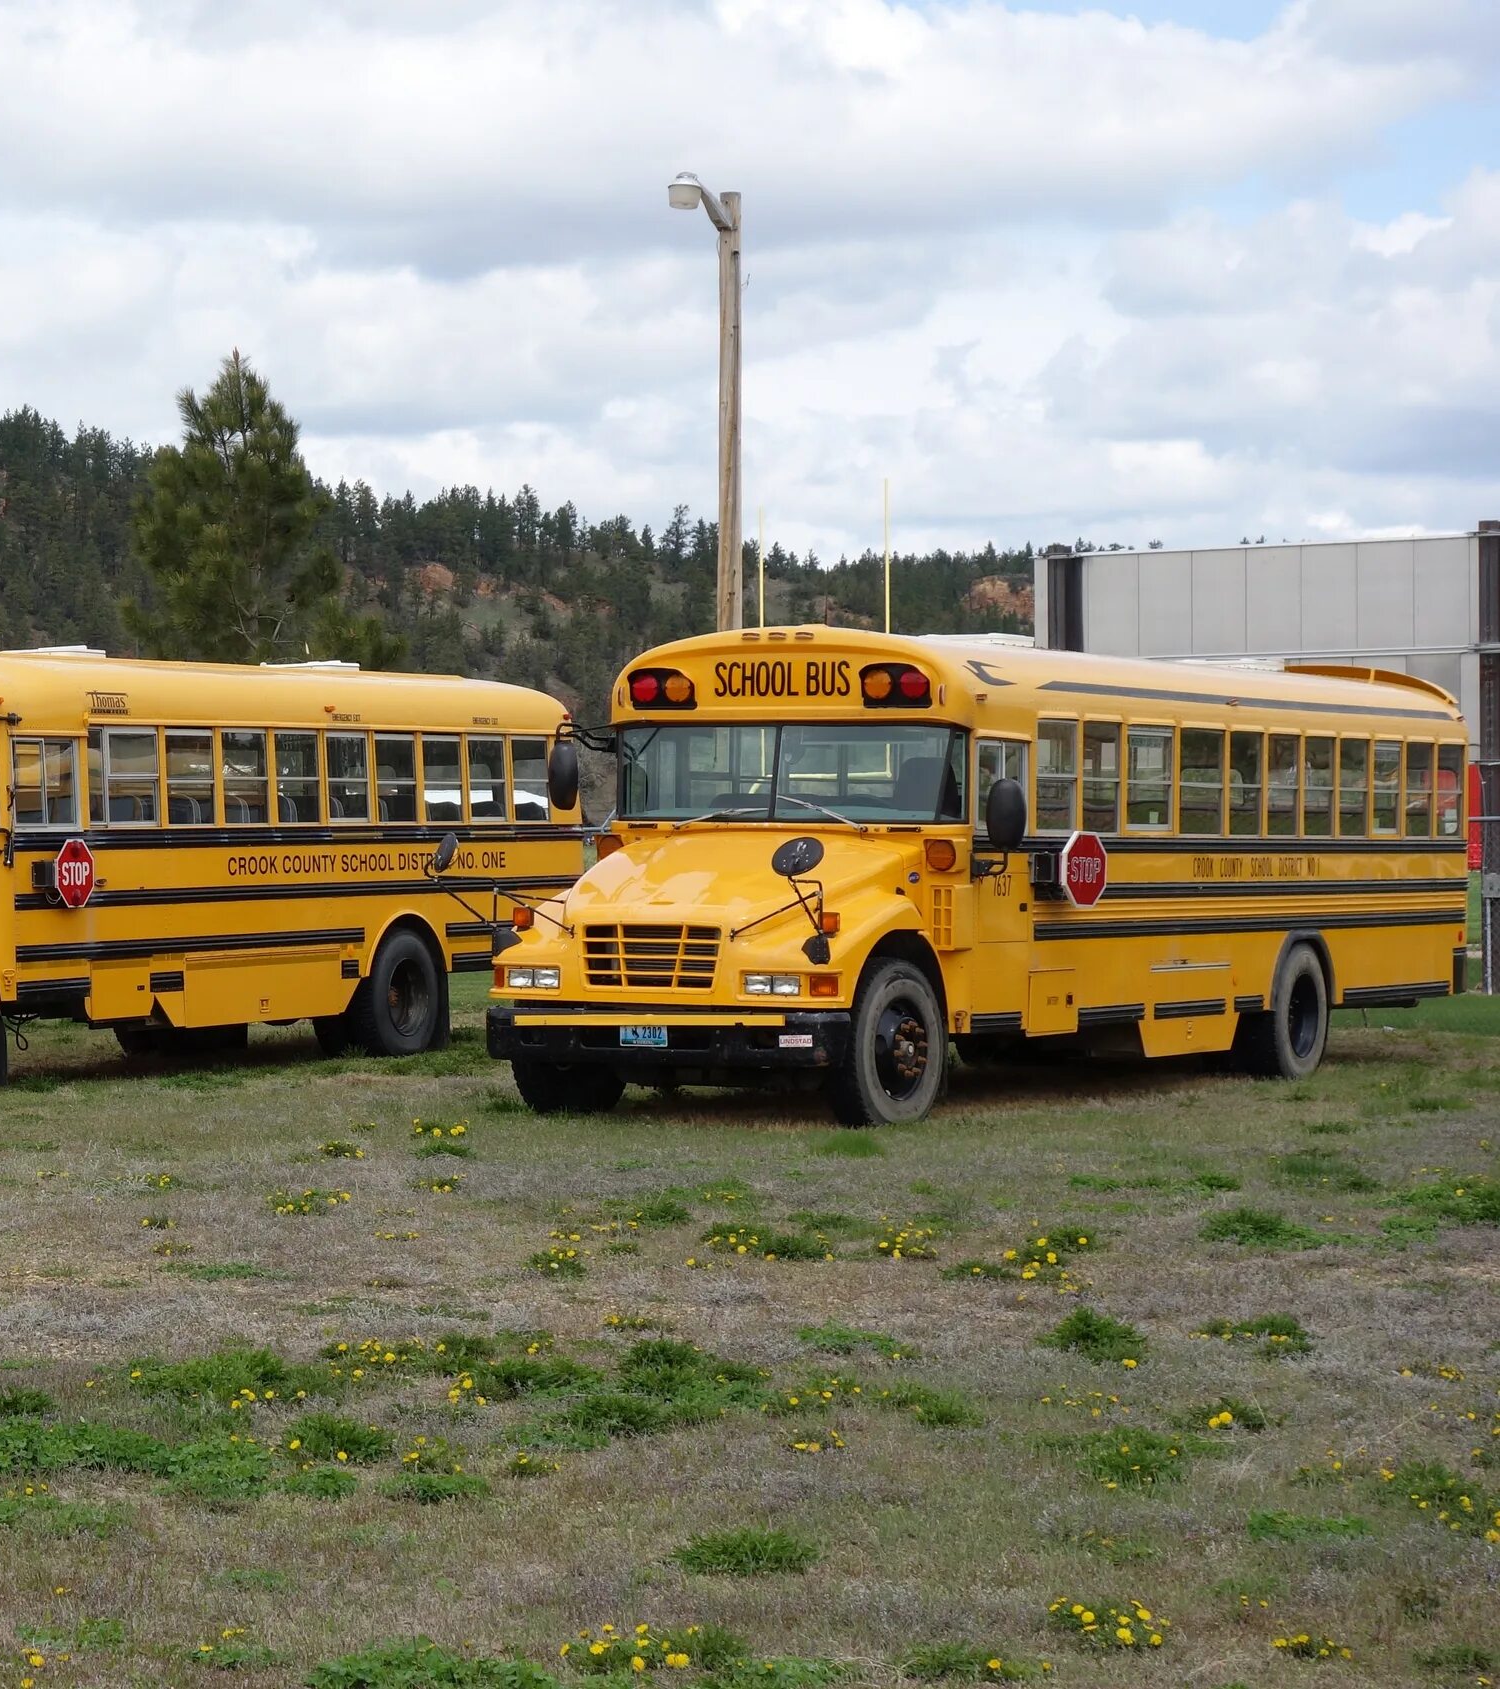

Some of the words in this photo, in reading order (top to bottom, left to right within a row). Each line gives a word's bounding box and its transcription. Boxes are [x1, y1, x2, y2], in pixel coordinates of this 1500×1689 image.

[715, 661, 799, 697] SCHOOL
[806, 660, 850, 696] BUS
[85, 690, 128, 708] Thomas
[62, 861, 90, 886] STOP
[228, 856, 278, 876] CROOK
[283, 855, 337, 874] COUNTY
[341, 853, 394, 872] SCHOOL
[457, 851, 478, 869] NO.
[482, 851, 506, 868] ONE
[1070, 856, 1102, 884] STOP
[1193, 857, 1213, 877] CROOK
[1220, 857, 1243, 877] COUNTY
[1250, 857, 1273, 877] SCHOOL
[1279, 857, 1303, 876] DISTRICT
[993, 874, 1011, 896] 7637
[642, 1026, 662, 1039] 2302
